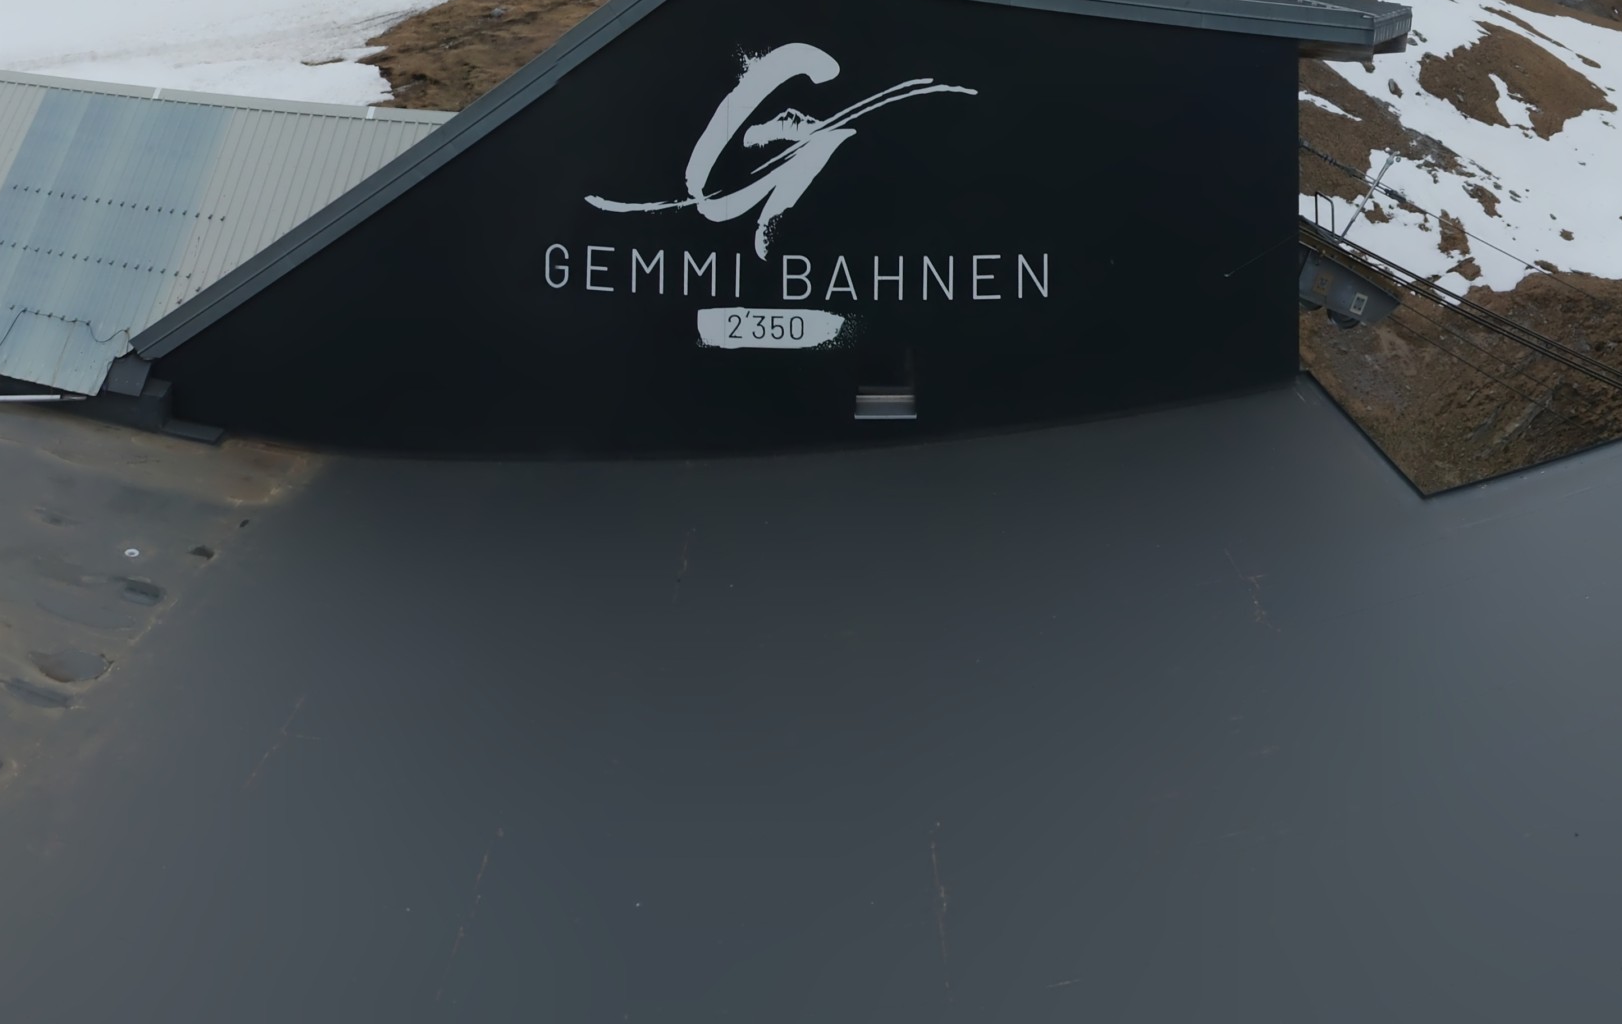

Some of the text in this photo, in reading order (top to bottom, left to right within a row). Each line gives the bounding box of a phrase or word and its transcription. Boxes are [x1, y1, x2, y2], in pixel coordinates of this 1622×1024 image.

[544, 243, 1050, 301] GEMMI BAHNEN
[726, 309, 806, 341] 2'350
